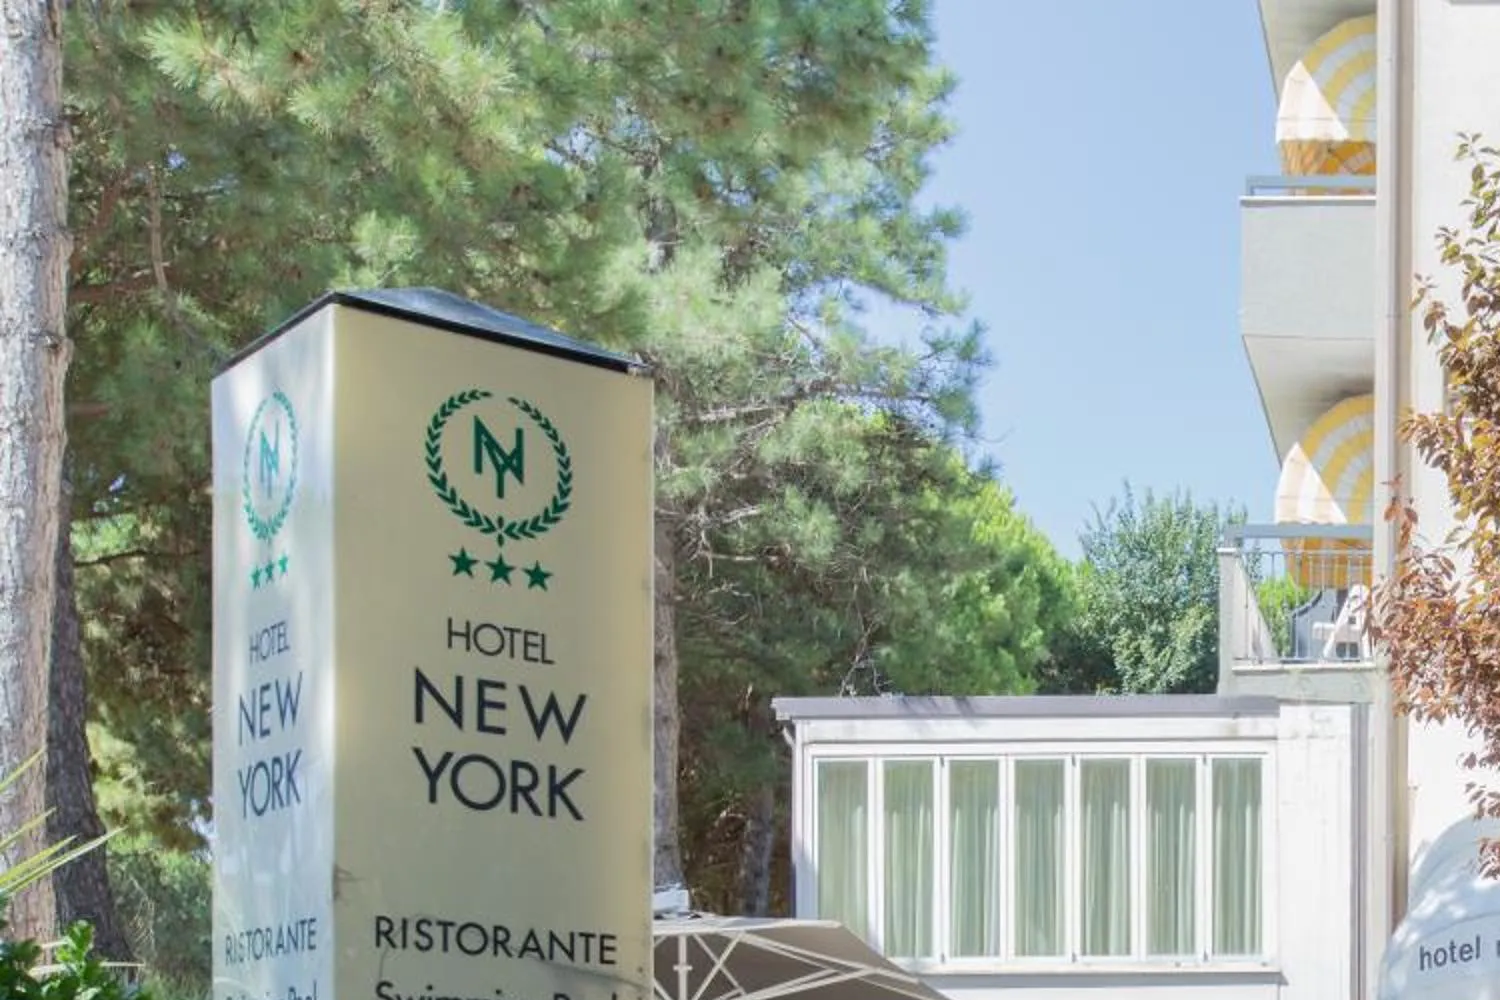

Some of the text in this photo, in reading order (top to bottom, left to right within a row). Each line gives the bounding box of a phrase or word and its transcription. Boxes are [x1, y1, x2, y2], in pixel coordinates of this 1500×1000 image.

[249, 619, 290, 663] HOTEL
[446, 617, 554, 665] HOTEL
[238, 670, 303, 747] NEW
[414, 666, 588, 745] NEW
[238, 748, 302, 820] YORK
[412, 747, 585, 821] YORK
[225, 918, 317, 967] RISTORANTE
[375, 915, 618, 965] RISTORANTE
[1419, 935, 1481, 971] hotel
